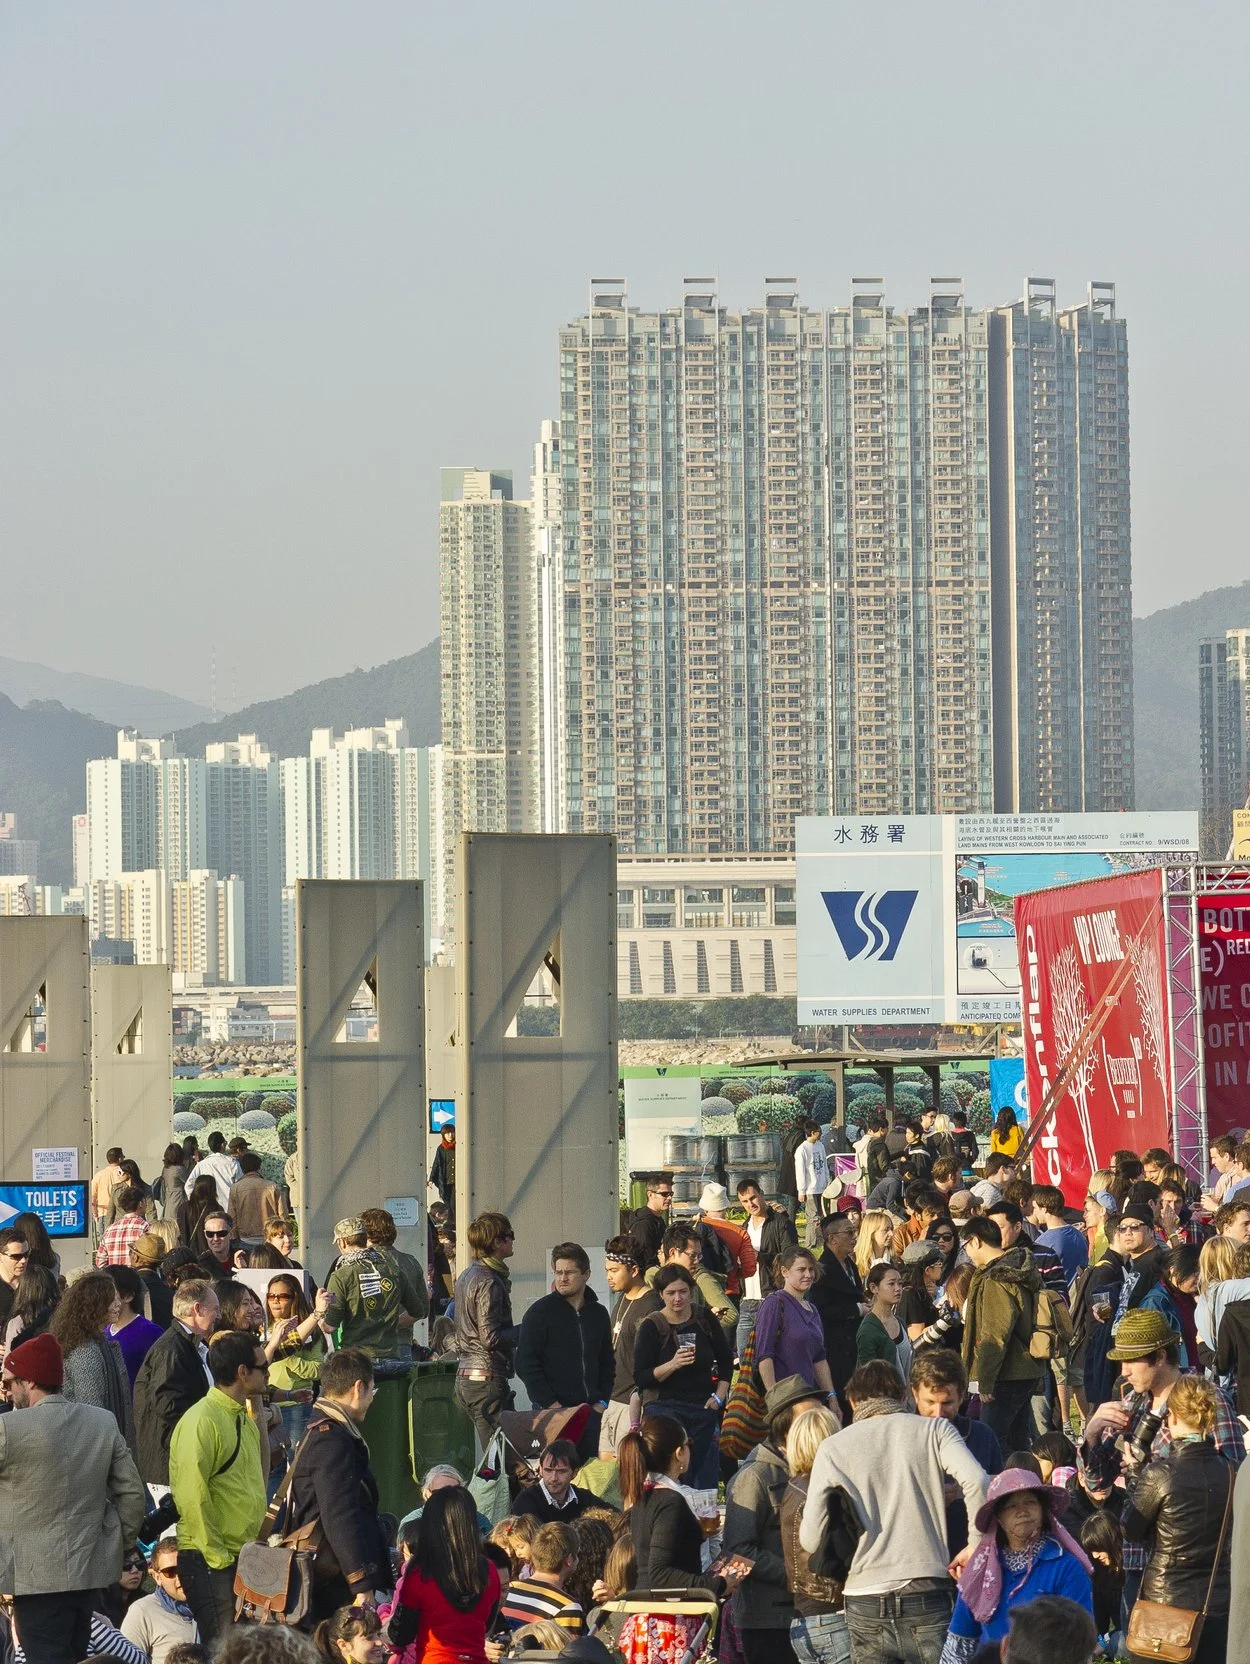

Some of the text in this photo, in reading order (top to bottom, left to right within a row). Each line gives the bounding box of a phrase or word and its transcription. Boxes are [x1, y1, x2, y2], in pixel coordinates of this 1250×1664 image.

[834, 825, 905, 843] 水務署
[1073, 909, 1125, 965] VIP LOUNGE
[1202, 984, 1232, 1010] WE
[812, 1007, 930, 1017] WATER SUPPLIES DEPARTMENT
[960, 1012, 1002, 1020] ANTICIPATED
[1215, 1061, 1238, 1086] IN
[25, 1190, 77, 1207] TOILETS
[33, 1210, 78, 1227] 手間
